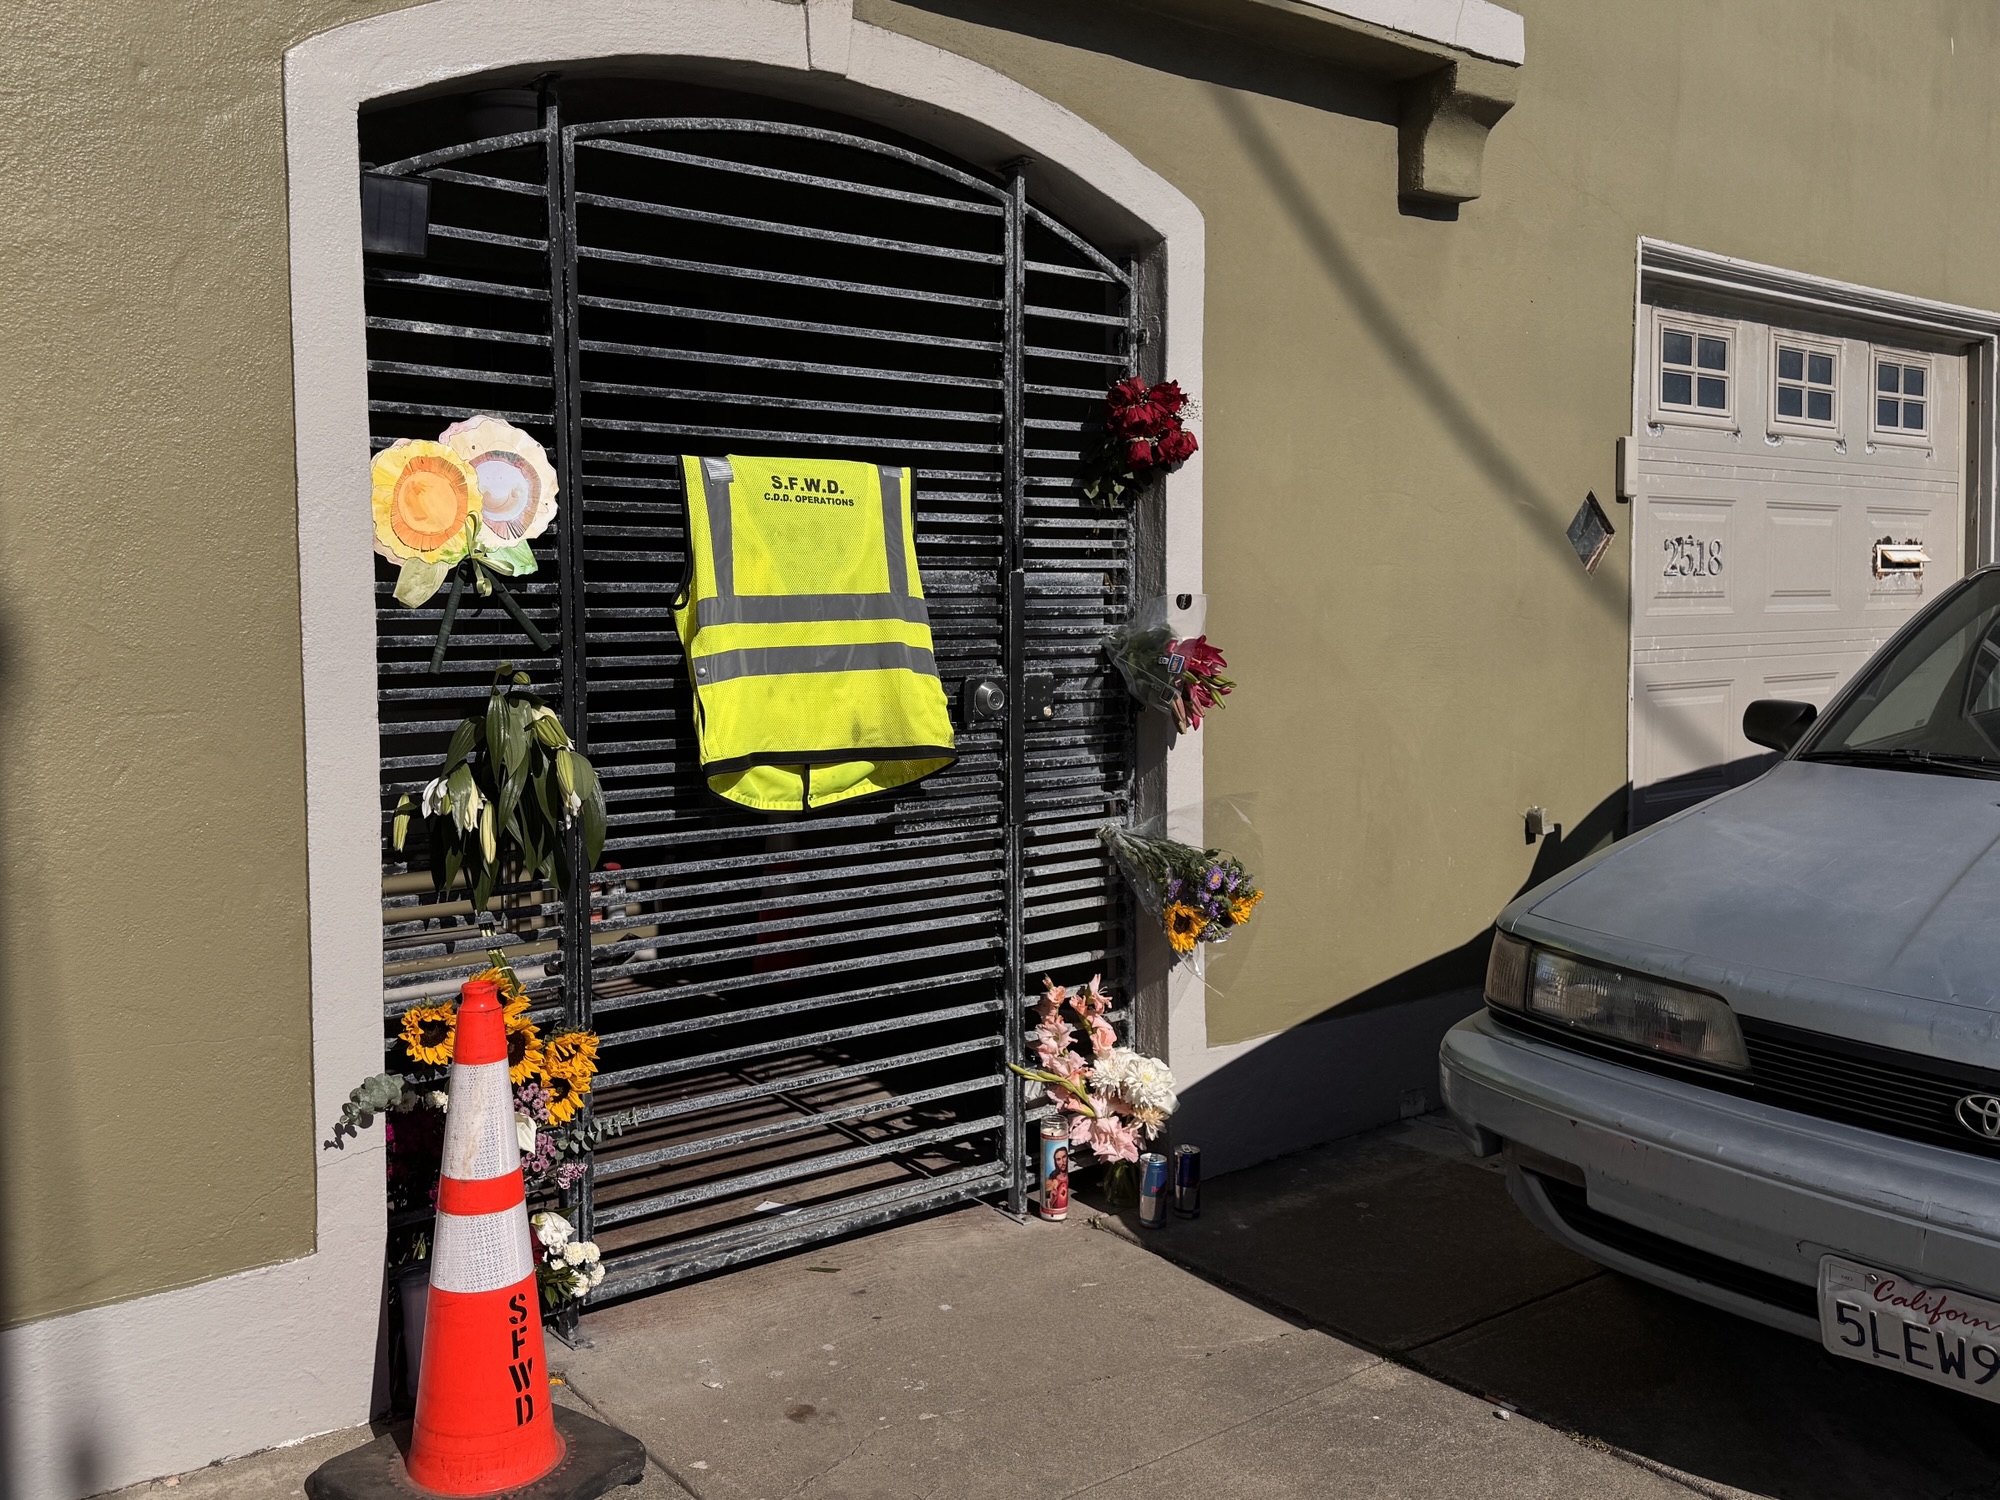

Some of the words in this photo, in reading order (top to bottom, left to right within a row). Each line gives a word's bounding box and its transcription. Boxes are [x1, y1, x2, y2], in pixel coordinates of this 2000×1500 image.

[771, 475, 845, 494] S.F.W.D.
[764, 492, 792, 502] C.D.D.
[795, 495, 854, 506] OPERATIONS
[1663, 538, 1723, 577] 2518
